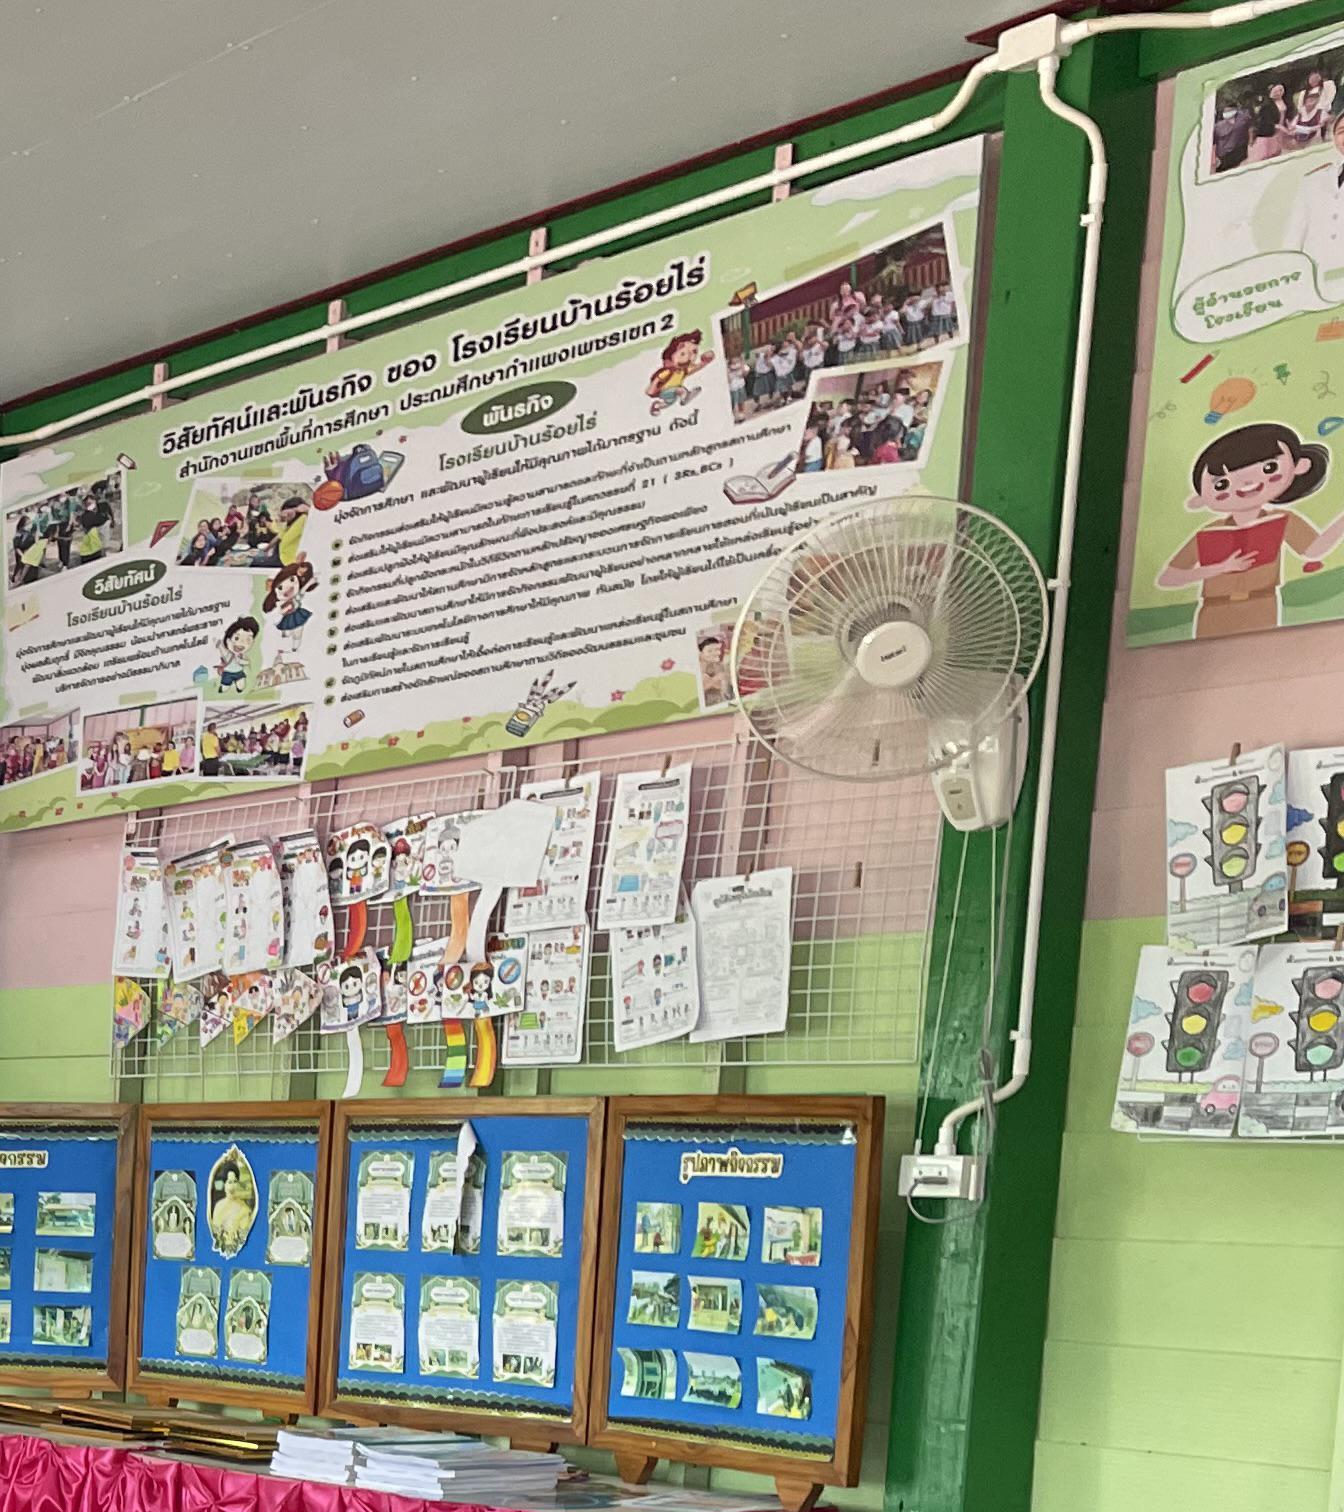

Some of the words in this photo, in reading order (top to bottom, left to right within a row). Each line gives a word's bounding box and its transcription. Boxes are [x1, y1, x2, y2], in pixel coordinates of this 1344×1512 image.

[162, 372, 372, 454] วิสัยทัศน์และพันธกิจ
[387, 352, 437, 383] ของ
[452, 256, 706, 362] โรงเรียนบ้านร้อยไร่
[179, 404, 389, 478] สำนักงานเขตพื้นที่การศึกษา
[661, 313, 674, 331] 2
[482, 393, 554, 427] พันธกิจ
[439, 411, 598, 470] โรงเรียนบ้านร้อยไร่
[94, 564, 155, 594] วิสัยทัศน์
[67, 585, 183, 627] โรงเรียนบ้านร้อยไร่
[683, 1151, 781, 1180] รูปภาพกิจกรรม
